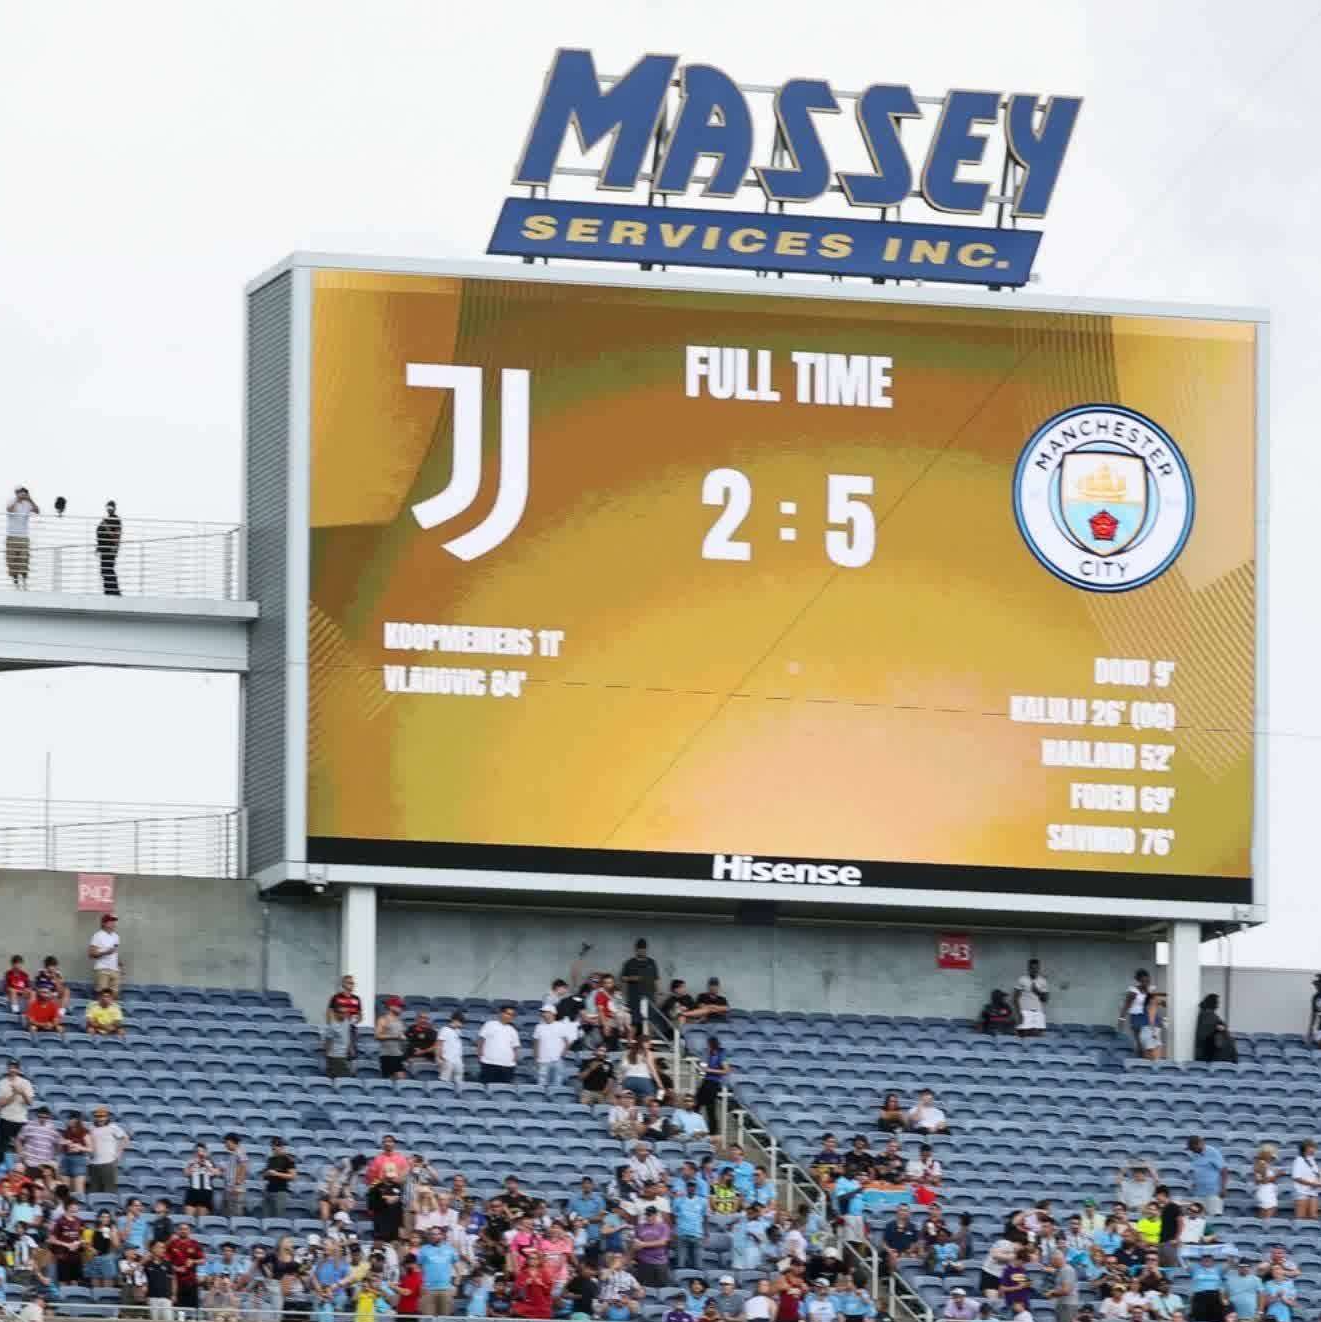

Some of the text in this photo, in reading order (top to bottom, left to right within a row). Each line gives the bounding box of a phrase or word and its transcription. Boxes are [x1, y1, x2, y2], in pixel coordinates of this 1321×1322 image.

[512, 47, 1084, 218] MASSEY
[521, 214, 1010, 269] SERVICES INC.
[685, 344, 894, 409] FULL TIME
[1035, 419, 1174, 477] MANCHESTER
[701, 467, 753, 561] 2
[825, 473, 877, 568] 5
[1079, 560, 1129, 578] CITY
[711, 853, 863, 887] Hisense
